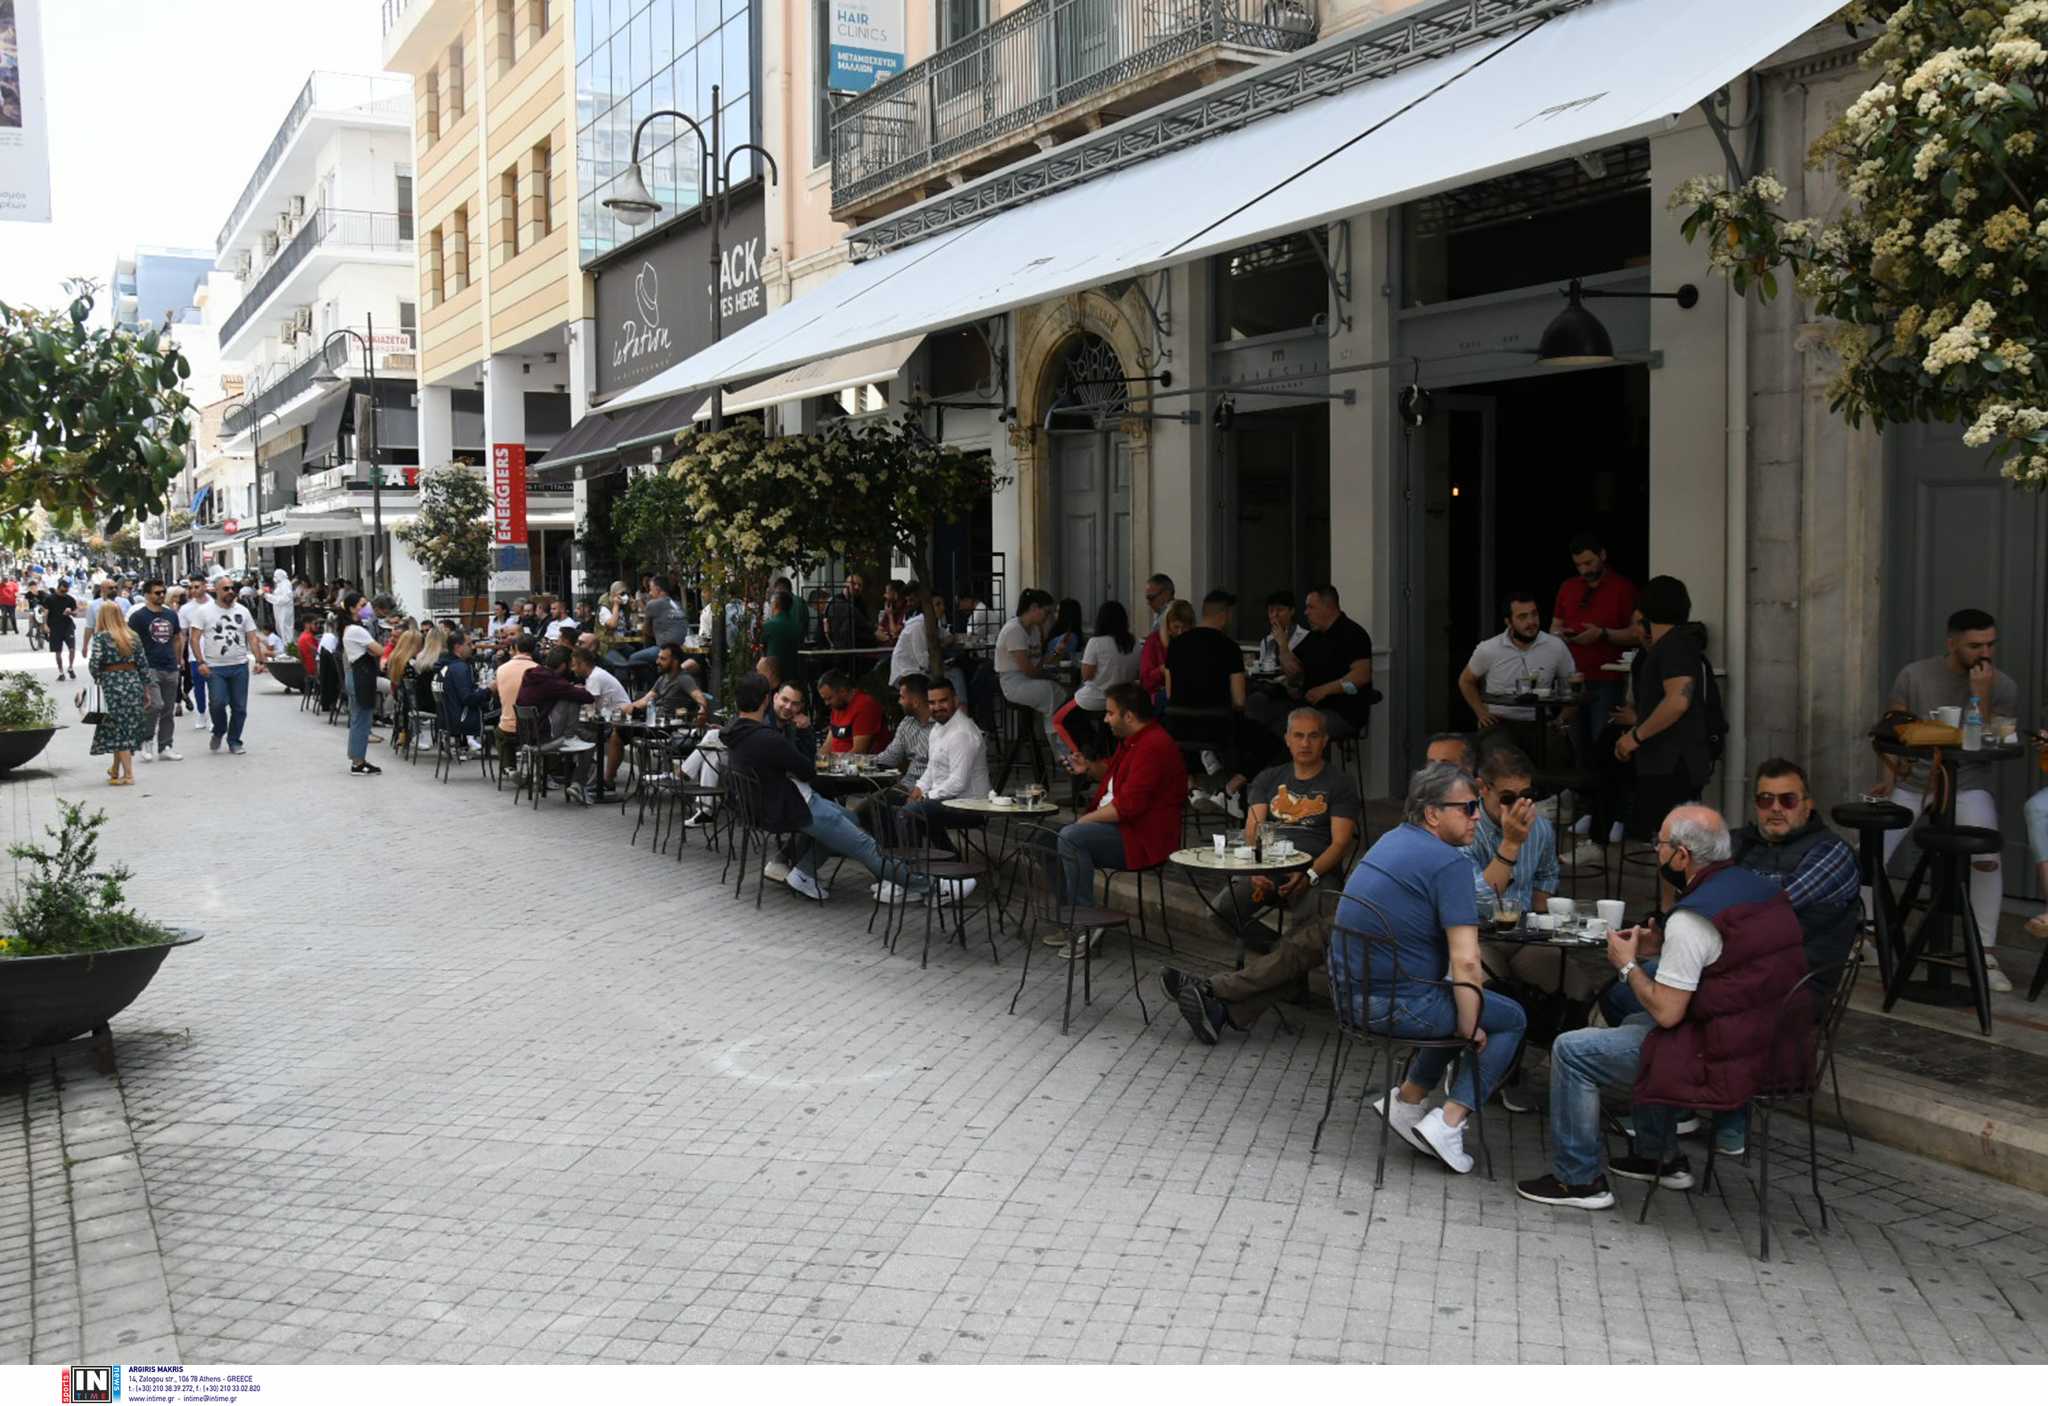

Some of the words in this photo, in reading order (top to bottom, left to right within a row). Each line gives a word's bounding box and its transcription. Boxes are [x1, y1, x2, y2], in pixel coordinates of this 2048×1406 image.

[837, 9, 869, 25] HAIR
[837, 24, 888, 42] CLINICS
[708, 237, 759, 297] ACK
[735, 286, 760, 313] HERE
[495, 446, 512, 541] ENERGIERS
